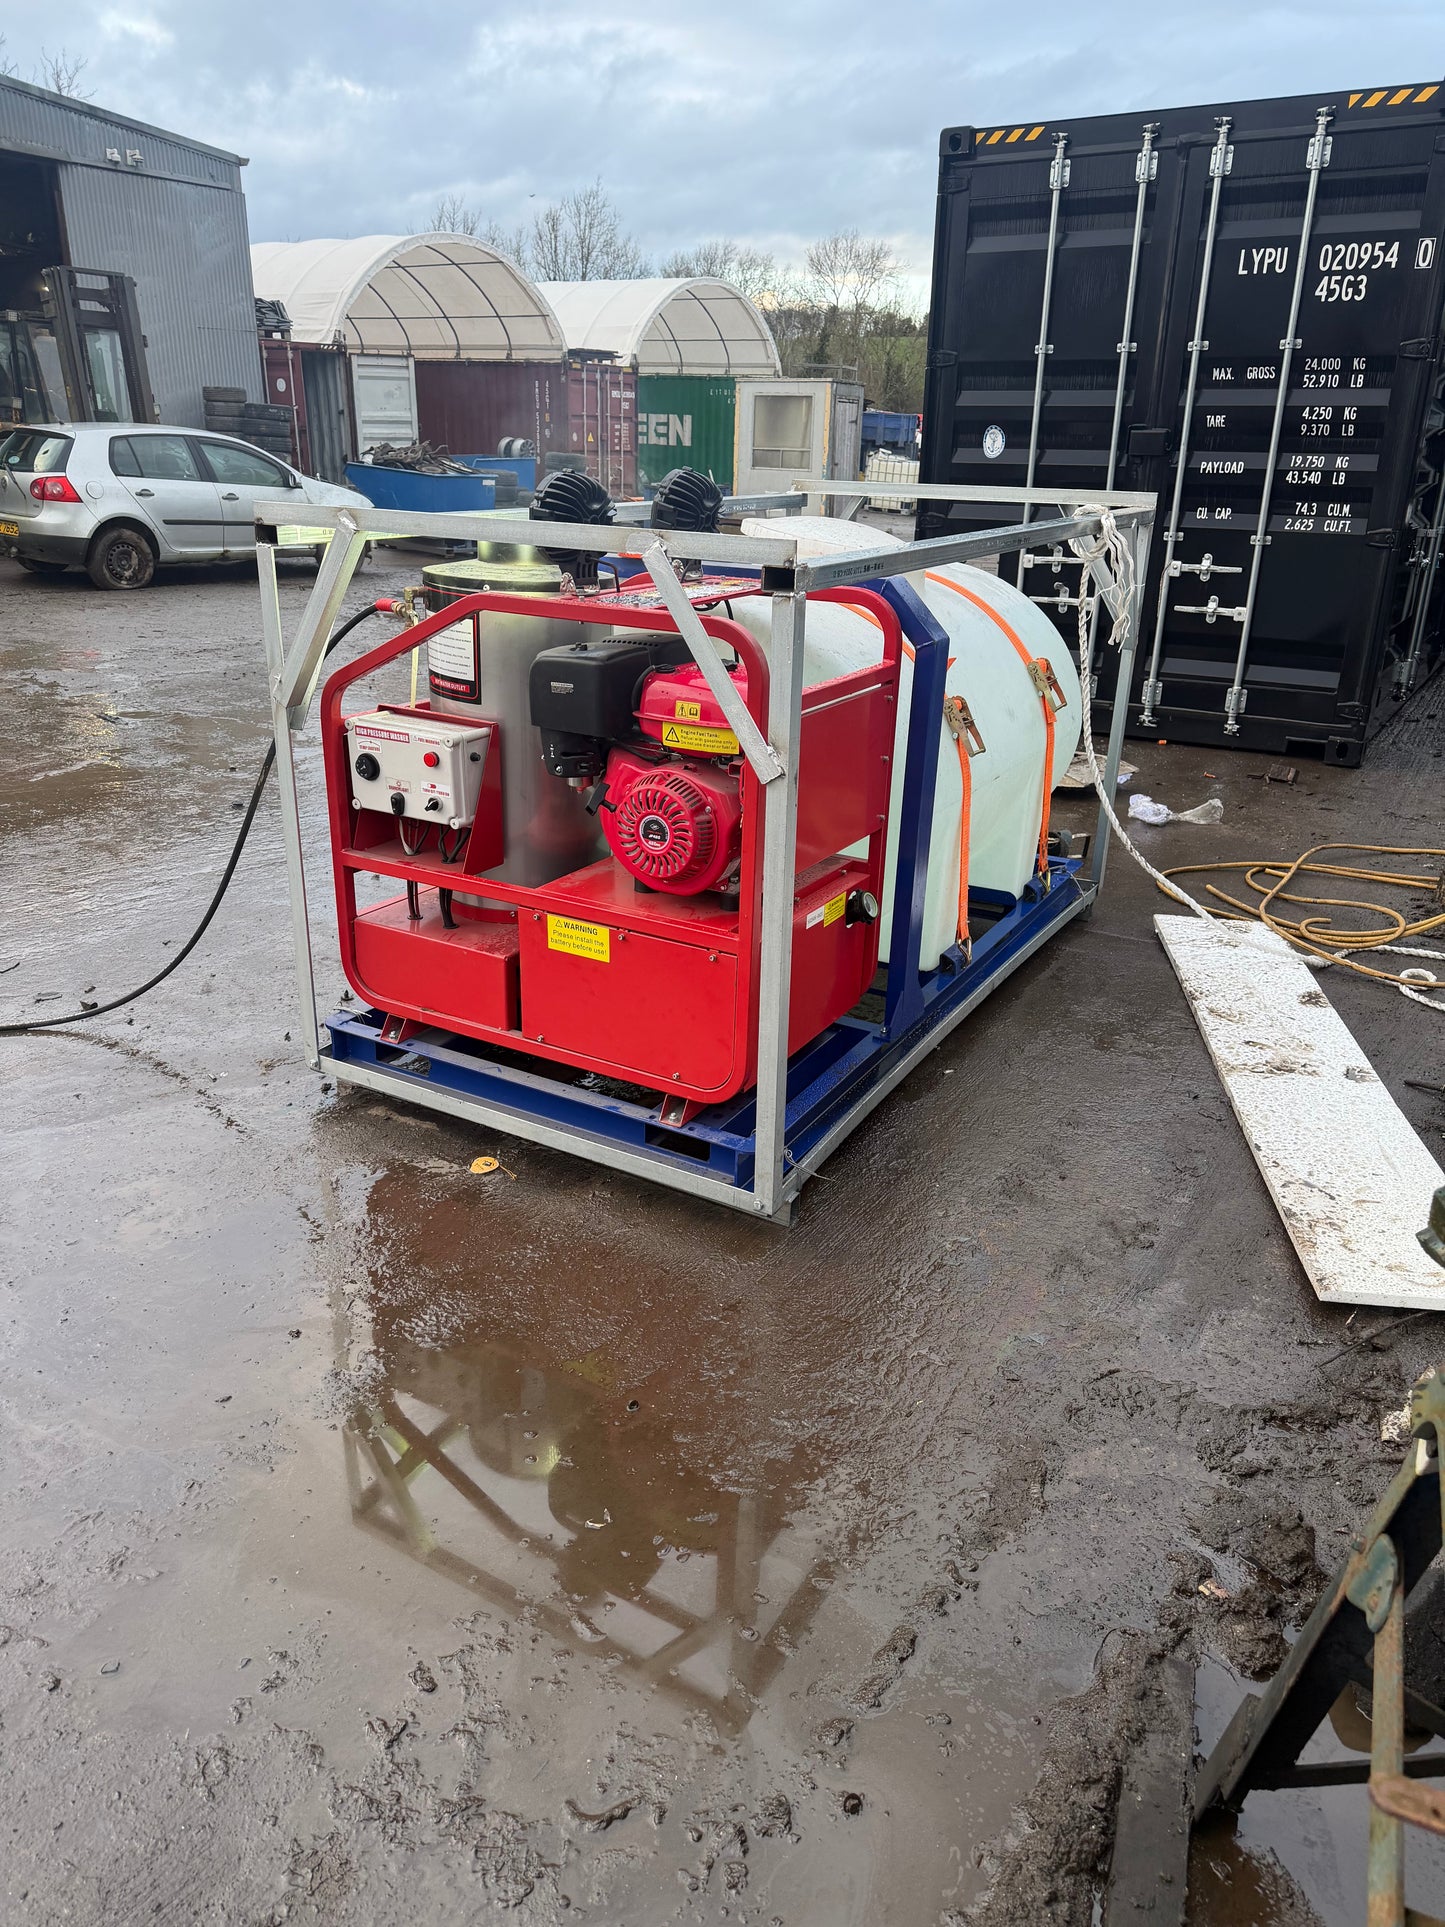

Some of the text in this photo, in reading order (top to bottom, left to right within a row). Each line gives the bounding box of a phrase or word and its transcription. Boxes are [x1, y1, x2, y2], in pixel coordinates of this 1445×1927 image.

[1238, 239, 1434, 275] LYPU 020954 0
[1315, 274, 1368, 302] 45G3
[1304, 358, 1366, 371] 24.000 KG
[1212, 366, 1275, 380] MAX. GROSS
[1302, 374, 1364, 388] 52.910 LB
[1302, 407, 1357, 420] 4.250 KG
[1206, 415, 1226, 427] TARE
[1300, 424, 1354, 436] 9.370 LB
[1200, 461, 1244, 473] PAYLOAD
[1290, 455, 1349, 468] 19.750 KG
[1286, 471, 1345, 485] 43.540 LB
[1196, 507, 1232, 520] CU. CAP.
[1295, 502, 1352, 517] 74.3 CU.M.
[1284, 519, 1314, 531] 2.625
[563, 922, 598, 935] WARNING
[553, 930, 573, 939] Please
[575, 934, 593, 944] install
[550, 937, 571, 947] battery
[572, 942, 592, 952] before
